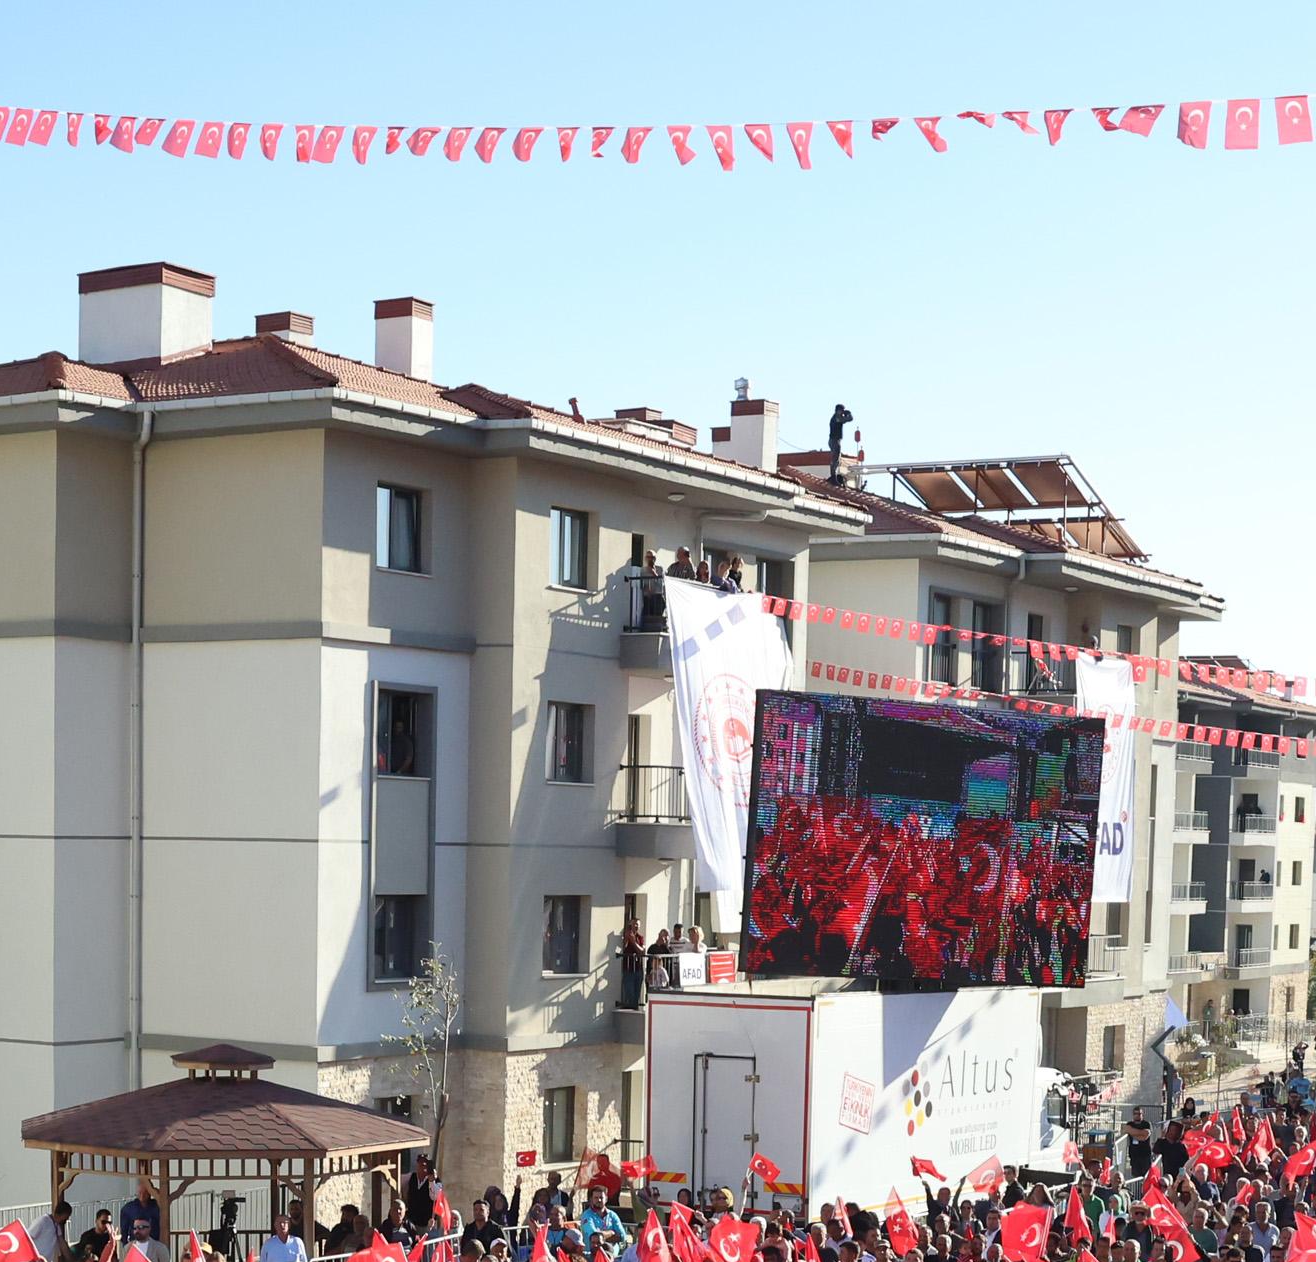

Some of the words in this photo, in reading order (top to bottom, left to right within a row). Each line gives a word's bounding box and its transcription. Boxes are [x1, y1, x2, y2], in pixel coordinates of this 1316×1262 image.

[683, 968, 702, 980] AFAD
[939, 1050, 1014, 1099] Altus
[980, 1134, 997, 1151] LED
